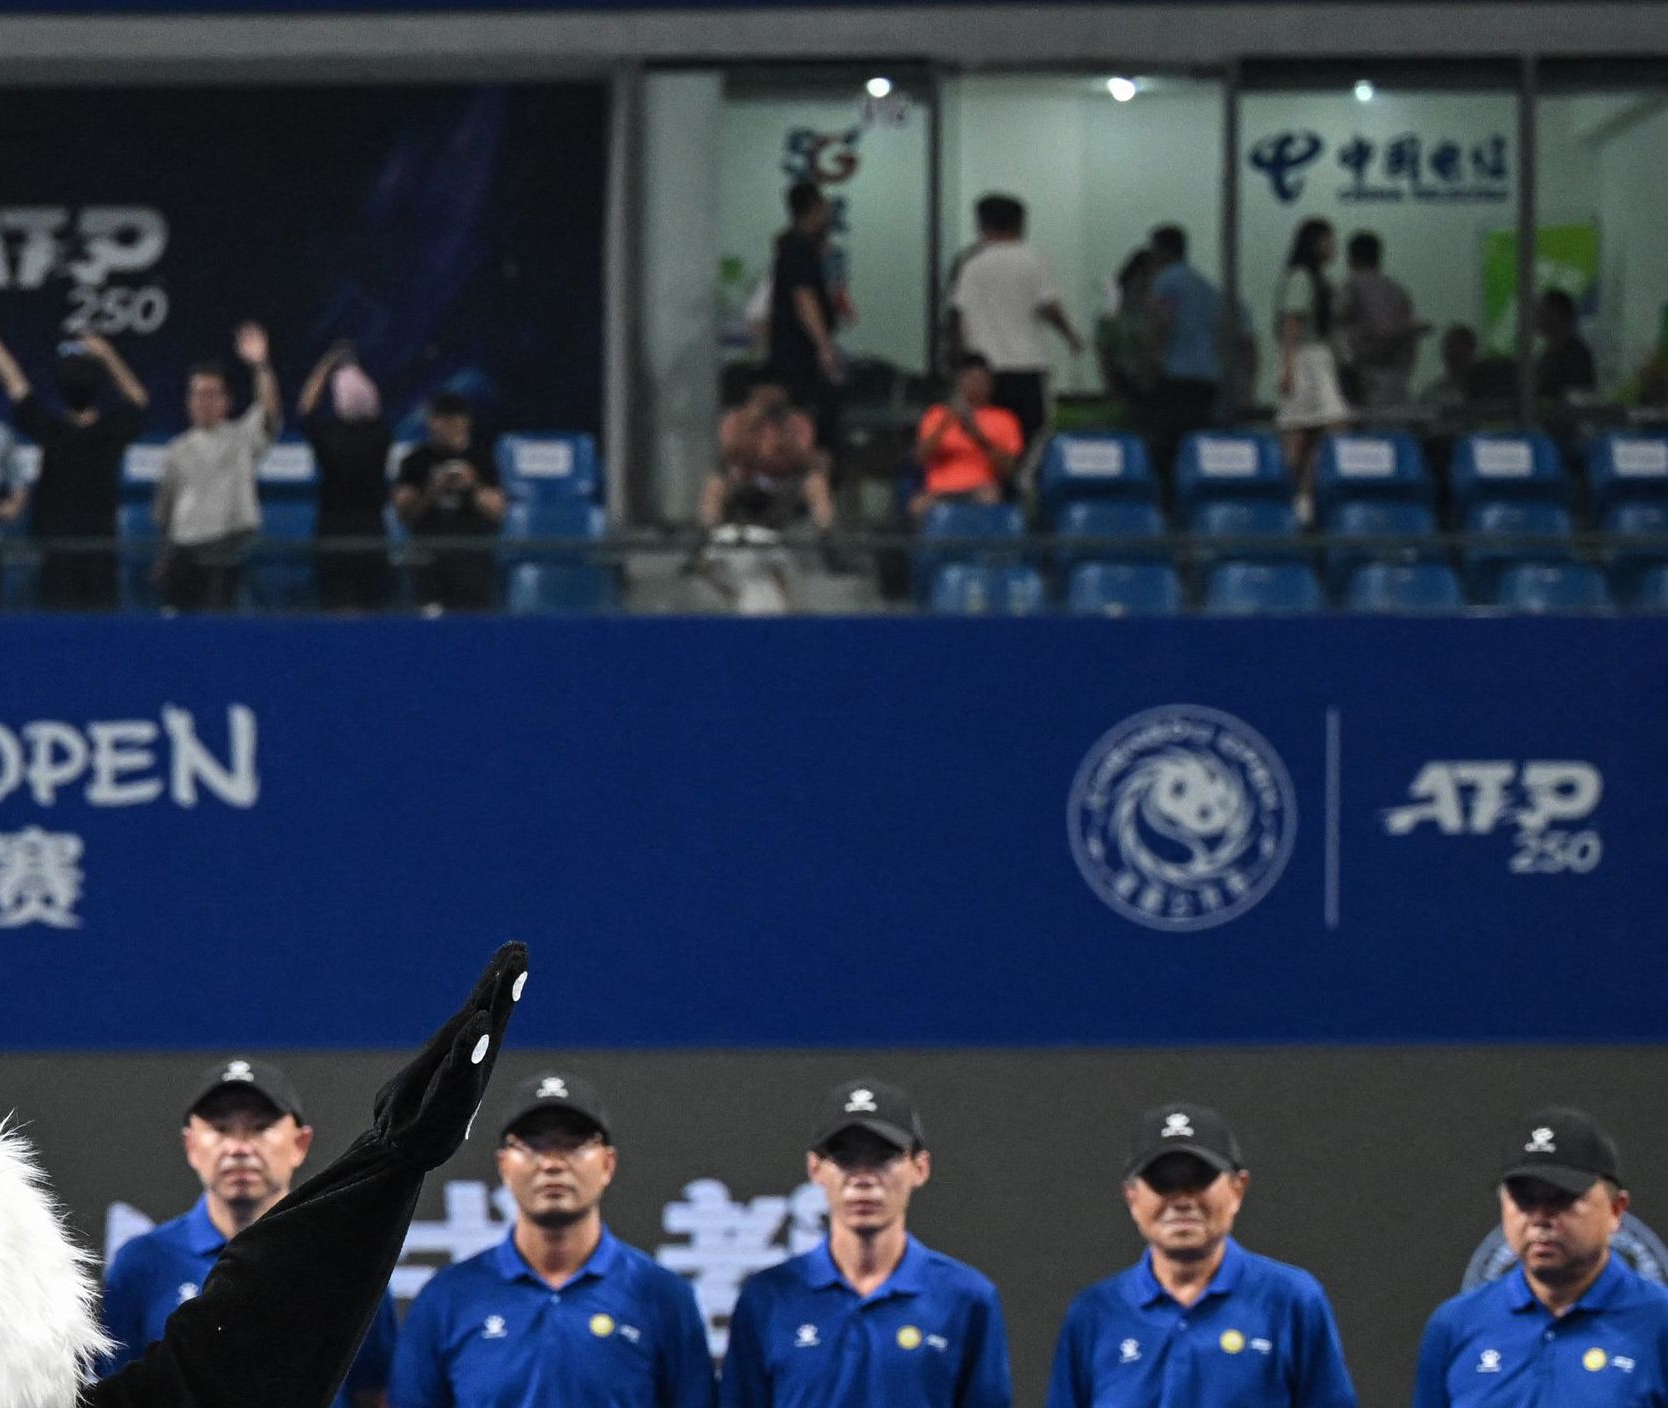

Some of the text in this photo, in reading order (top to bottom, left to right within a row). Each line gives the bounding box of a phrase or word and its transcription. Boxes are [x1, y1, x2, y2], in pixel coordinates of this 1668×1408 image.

[1337, 131, 1507, 188] 中国电信
[63, 286, 168, 336] 250
[1383, 760, 1604, 836] ATP
[1511, 829, 1603, 875] 250
